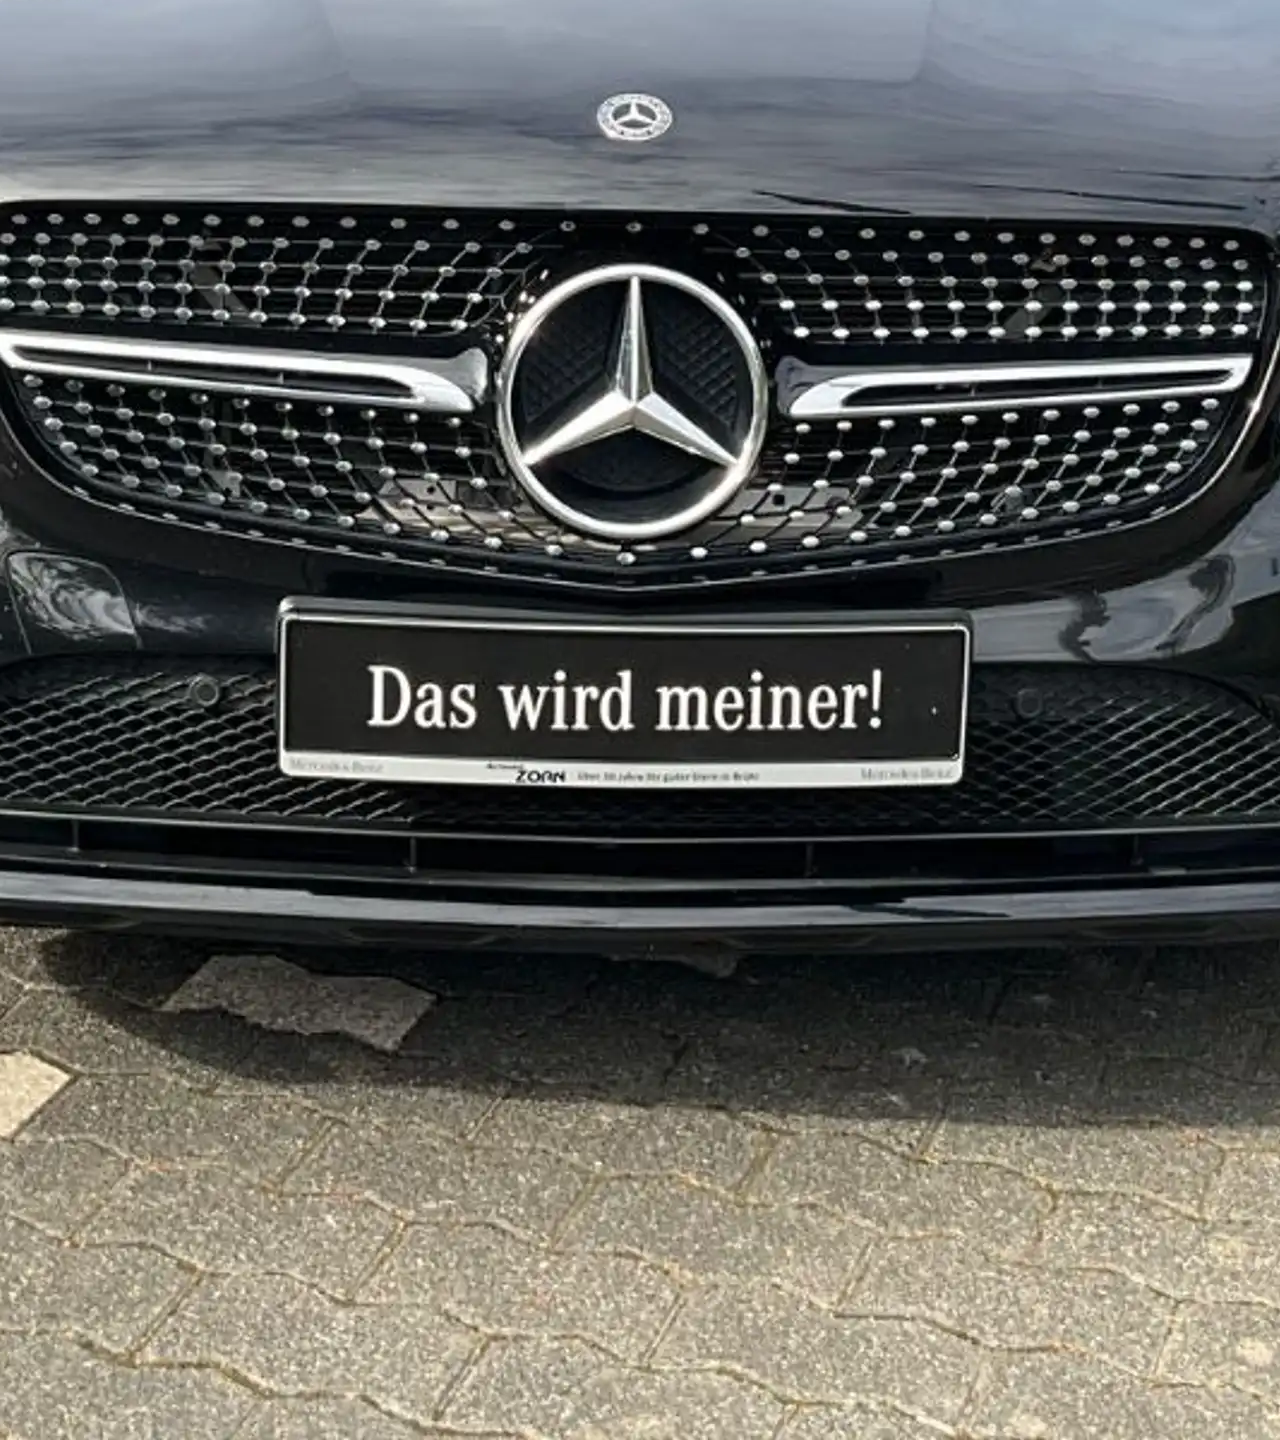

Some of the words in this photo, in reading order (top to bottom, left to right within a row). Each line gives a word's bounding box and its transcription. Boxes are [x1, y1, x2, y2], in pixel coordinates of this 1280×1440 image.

[367, 664, 477, 729] Das
[497, 669, 635, 732] wird
[655, 668, 883, 732] meiner!
